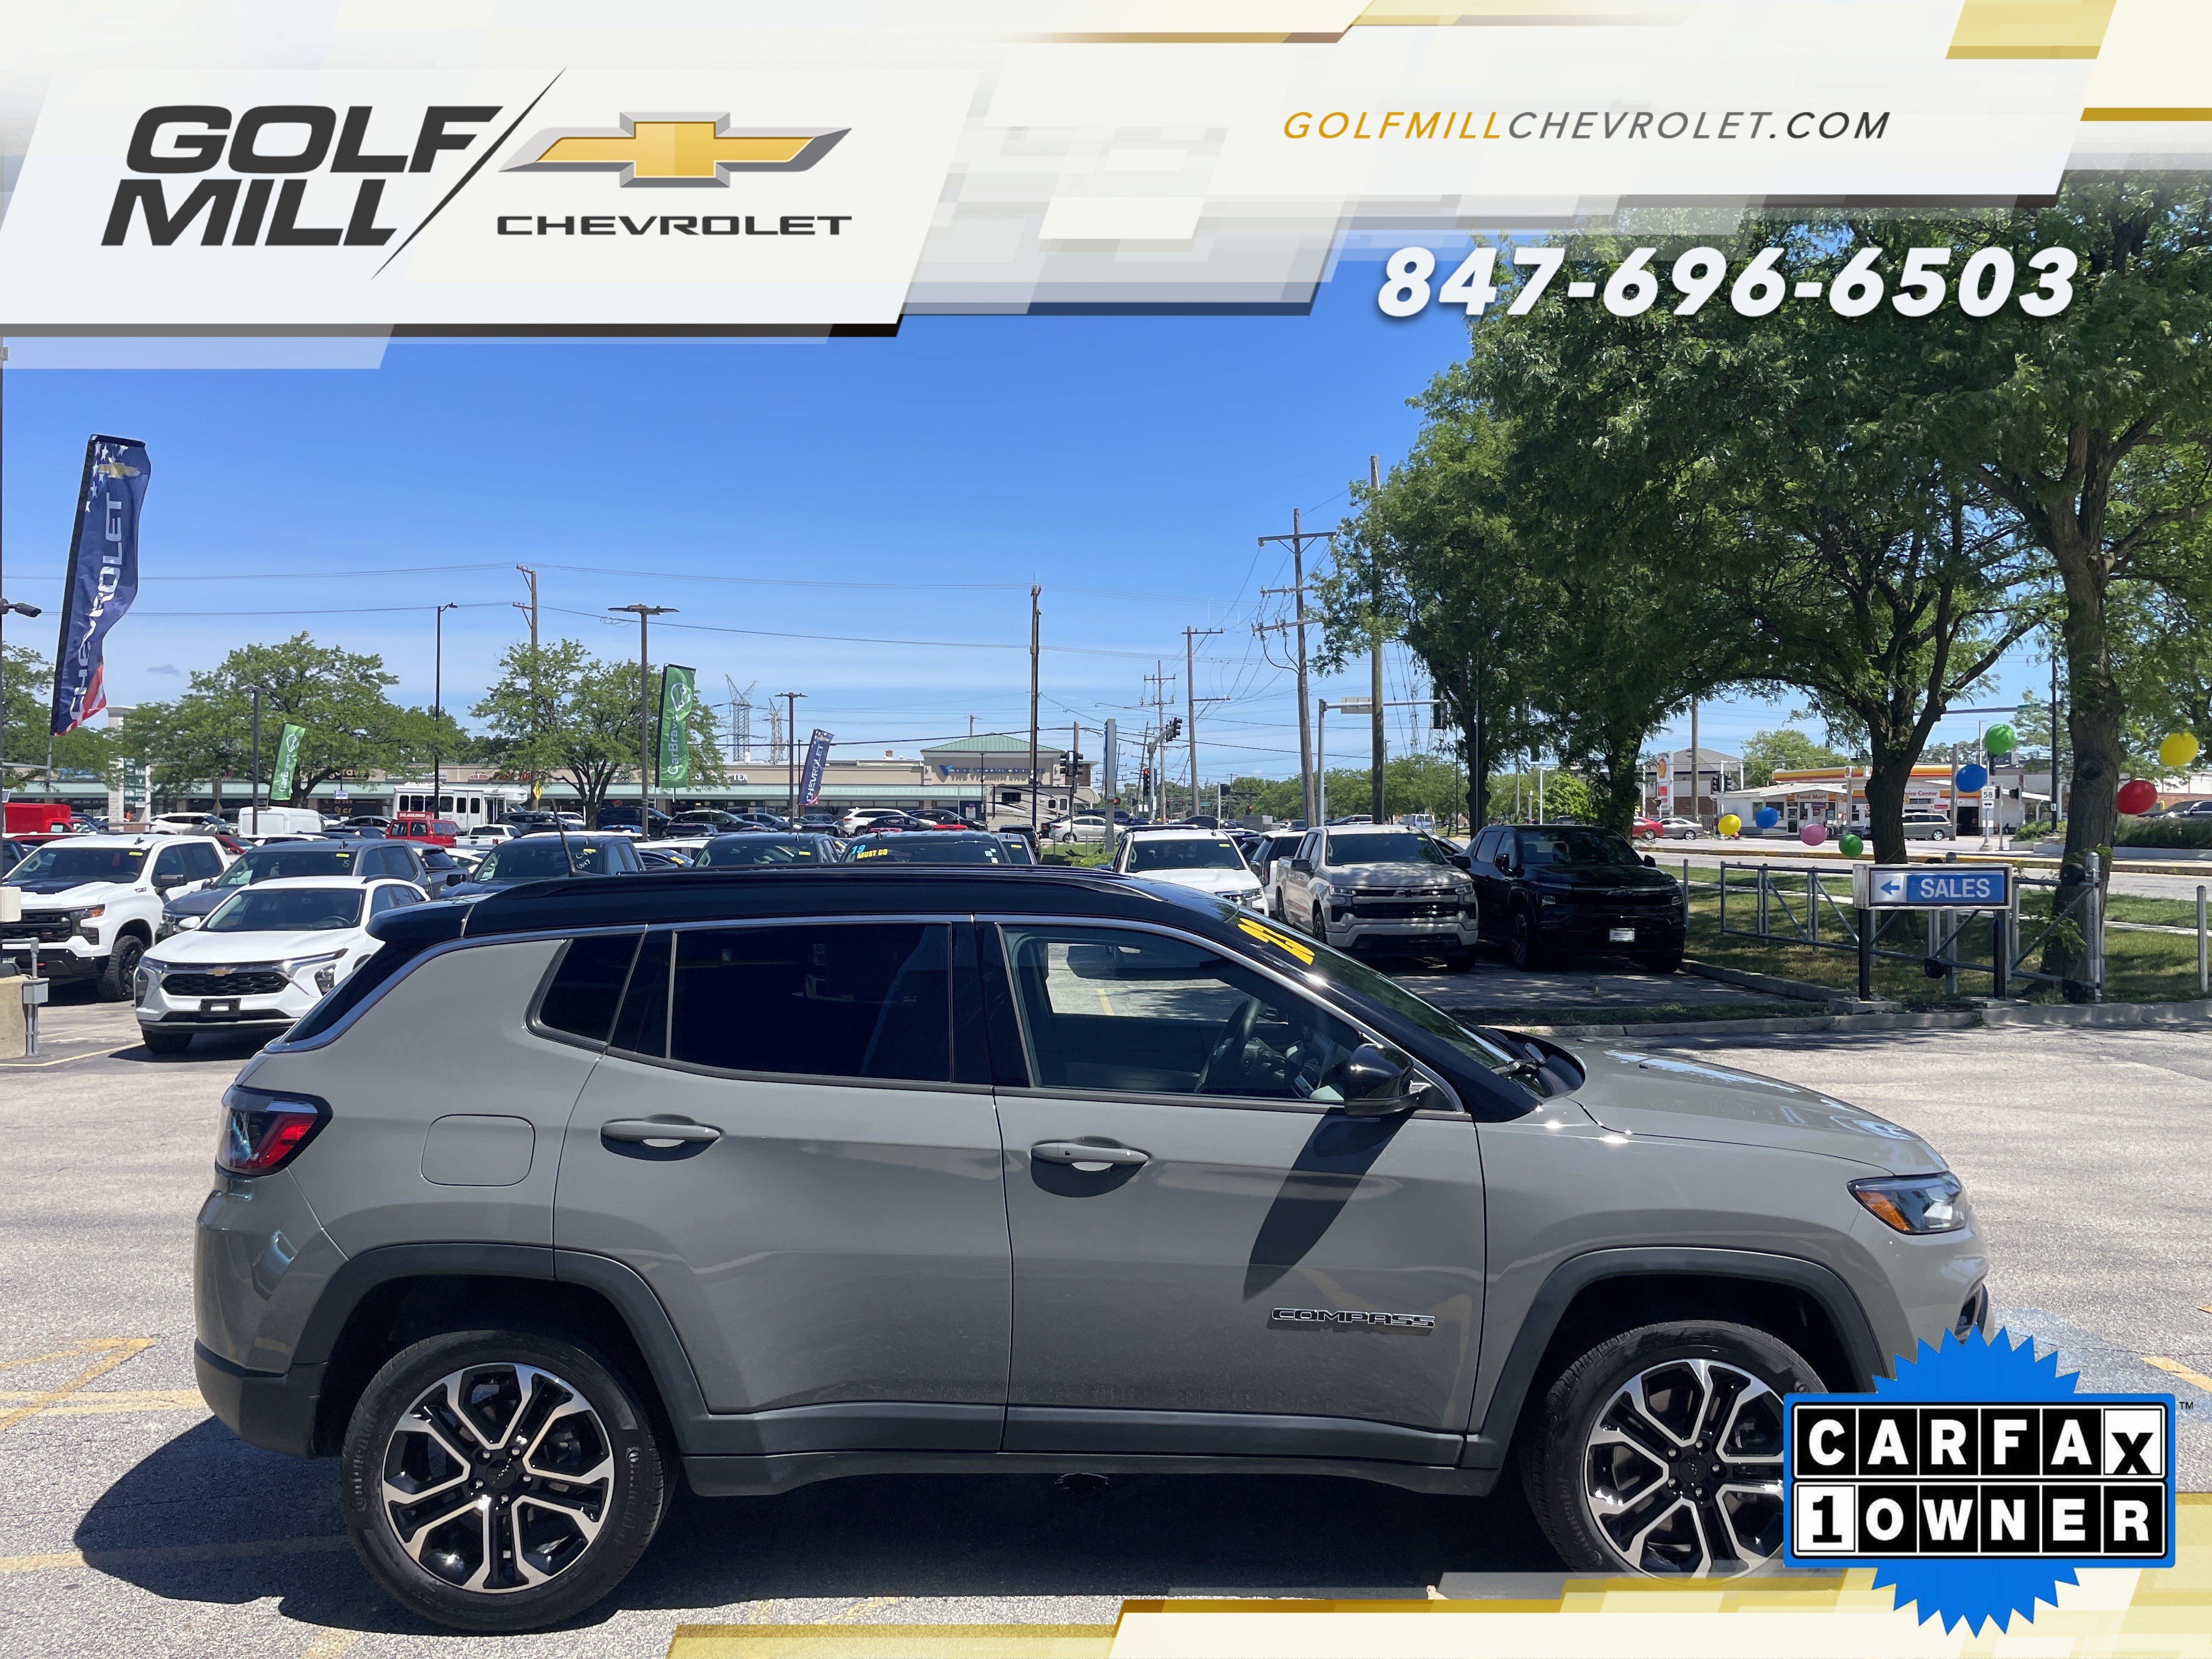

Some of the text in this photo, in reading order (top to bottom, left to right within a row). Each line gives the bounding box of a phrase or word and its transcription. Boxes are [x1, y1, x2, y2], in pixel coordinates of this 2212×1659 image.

[70, 492, 123, 720] CHEVROLET
[806, 743, 823, 802] CHEVROLET
[851, 844, 866, 854] 19
[856, 850, 877, 859] MUST
[1920, 878, 1991, 899] SALES
[1271, 1307, 1435, 1328] COMPASS
